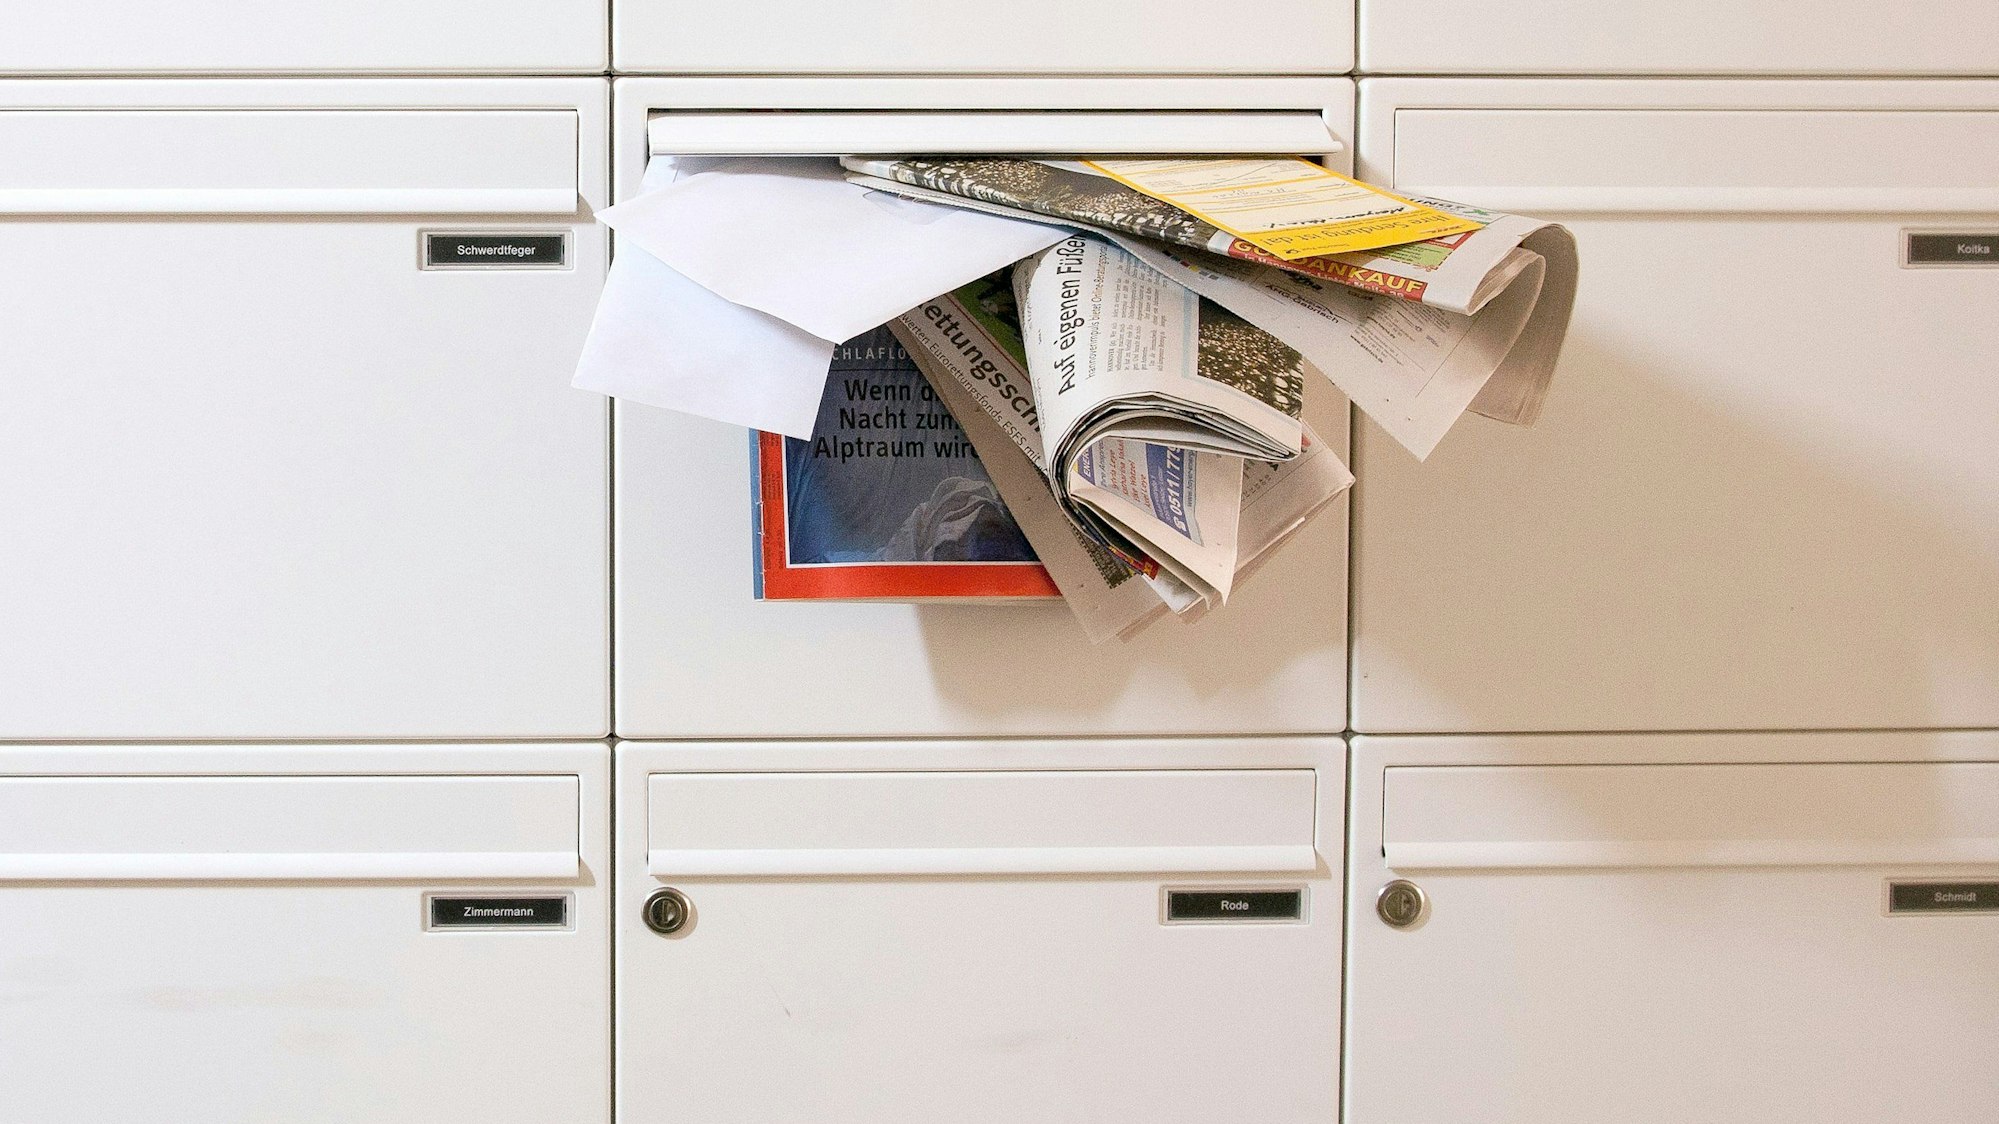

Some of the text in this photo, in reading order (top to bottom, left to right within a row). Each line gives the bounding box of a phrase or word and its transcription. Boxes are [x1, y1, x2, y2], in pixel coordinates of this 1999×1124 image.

[1411, 214, 1451, 224] Ihre
[1320, 221, 1410, 237] Sendung
[457, 244, 536, 257] Schwerdtfeger
[1957, 243, 1990, 254] Koitka
[1233, 240, 1423, 293] GODANKAUF
[1053, 279, 1085, 350] eigenen
[832, 347, 911, 361] CHLAFLO
[918, 303, 1040, 432] ettungssch
[1054, 353, 1075, 395] Auf
[844, 379, 911, 401] Wenn
[840, 406, 907, 430] Nacht
[814, 435, 924, 464] Alptraum
[1024, 446, 1042, 463] mit
[1934, 892, 1976, 902] Schmidt
[463, 906, 534, 917] Zimmermann
[1221, 900, 1249, 911] Rode
